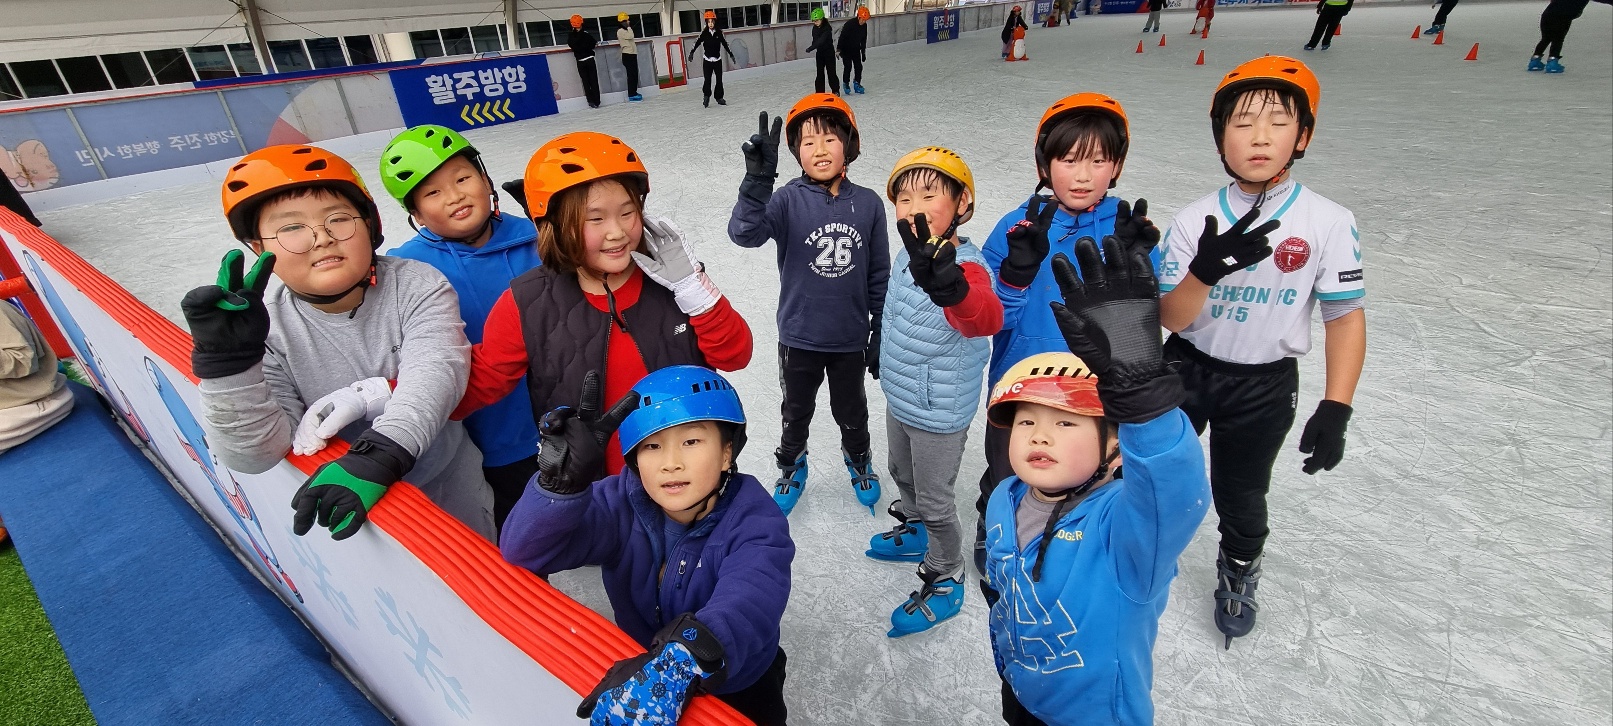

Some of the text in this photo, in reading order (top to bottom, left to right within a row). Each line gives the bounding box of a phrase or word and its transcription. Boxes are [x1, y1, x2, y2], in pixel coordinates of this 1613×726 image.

[424, 64, 527, 105] 활주방향
[804, 223, 862, 249] TKJ SPORTIVE
[815, 236, 853, 267] 26
[1208, 285, 1298, 305] CHEON FC
